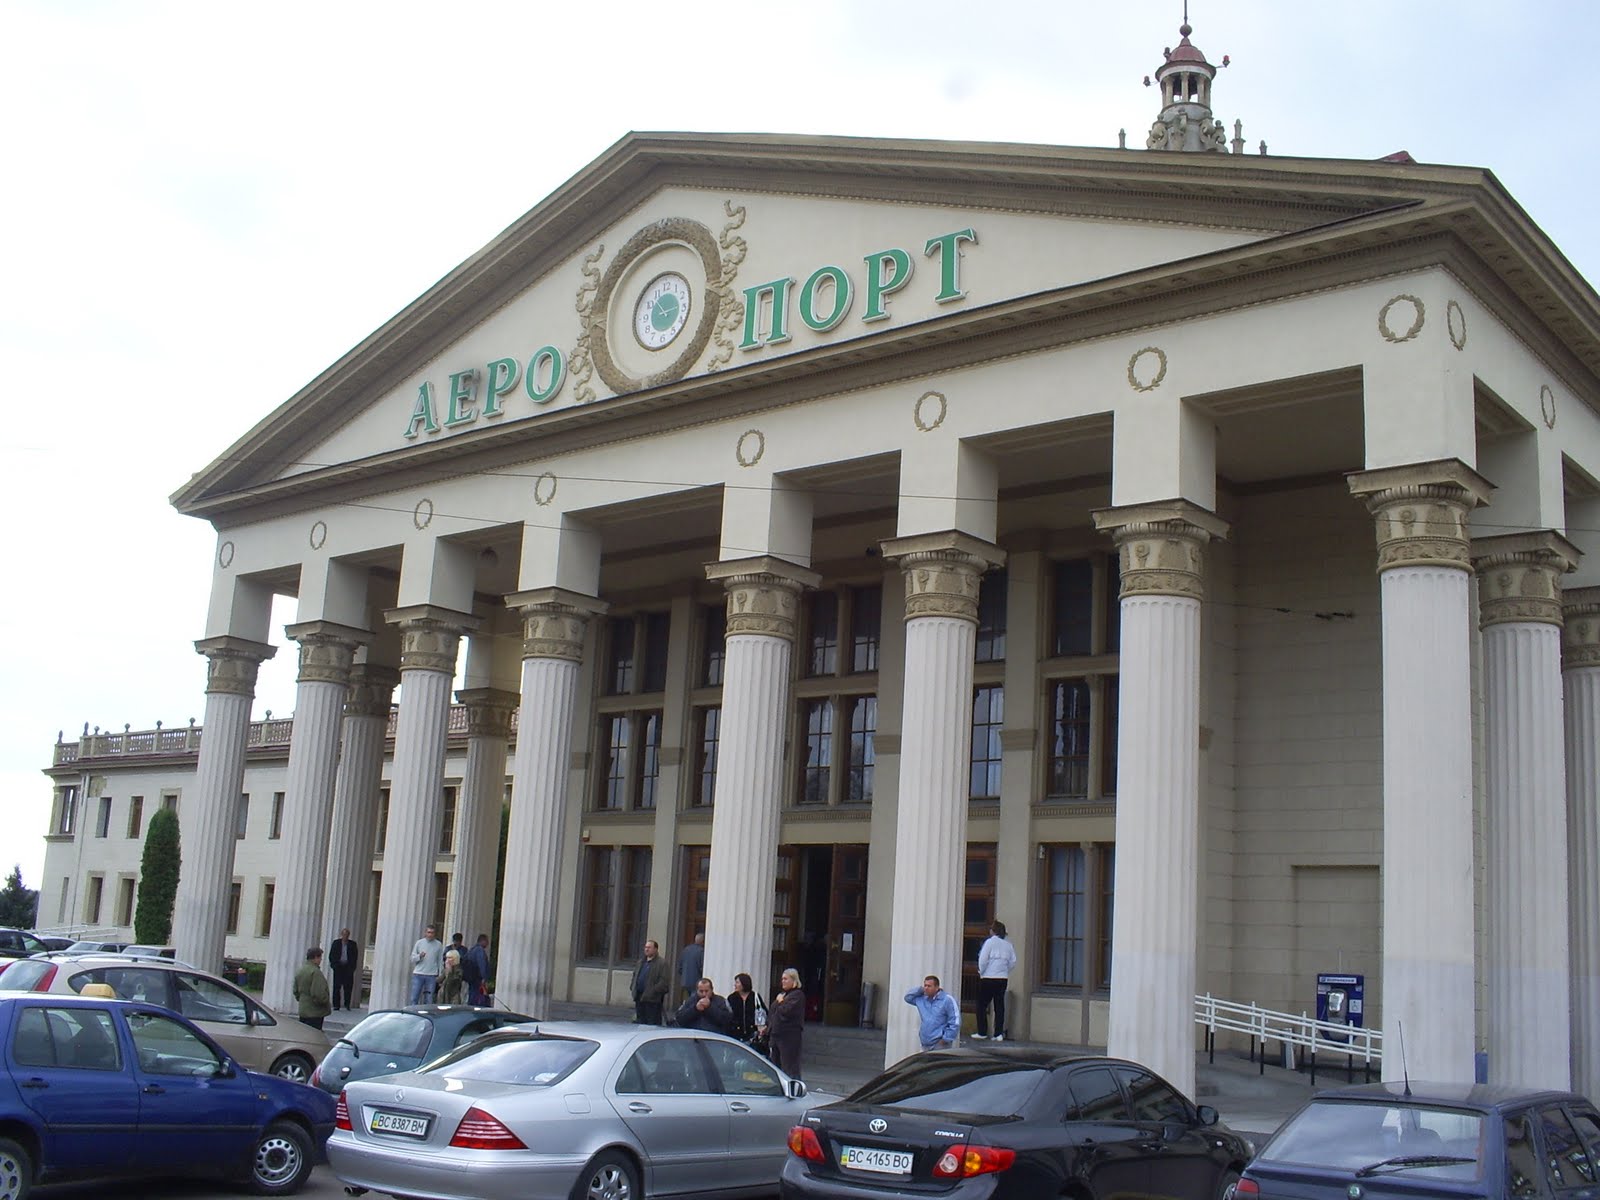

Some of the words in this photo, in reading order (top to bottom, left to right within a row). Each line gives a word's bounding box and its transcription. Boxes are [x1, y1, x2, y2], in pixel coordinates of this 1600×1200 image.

[663, 282, 670, 292] 12
[654, 290, 660, 299] 11
[680, 291, 685, 300] 2
[646, 300, 654, 310] 10
[681, 303, 686, 312] 3
[643, 314, 648, 323] 9
[403, 344, 567, 439] АЕРО
[738, 228, 978, 351] ПОРТ
[645, 325, 650, 334] 8
[670, 326, 676, 335] 5
[651, 332, 656, 341] 7
[660, 334, 666, 342] 6
[377, 1115, 391, 1128] BC
[391, 1117, 411, 1130] 8387
[411, 1121, 425, 1133] BM
[848, 1149, 863, 1163] BC
[866, 1152, 890, 1168] 4165
[892, 1155, 910, 1169] BO
